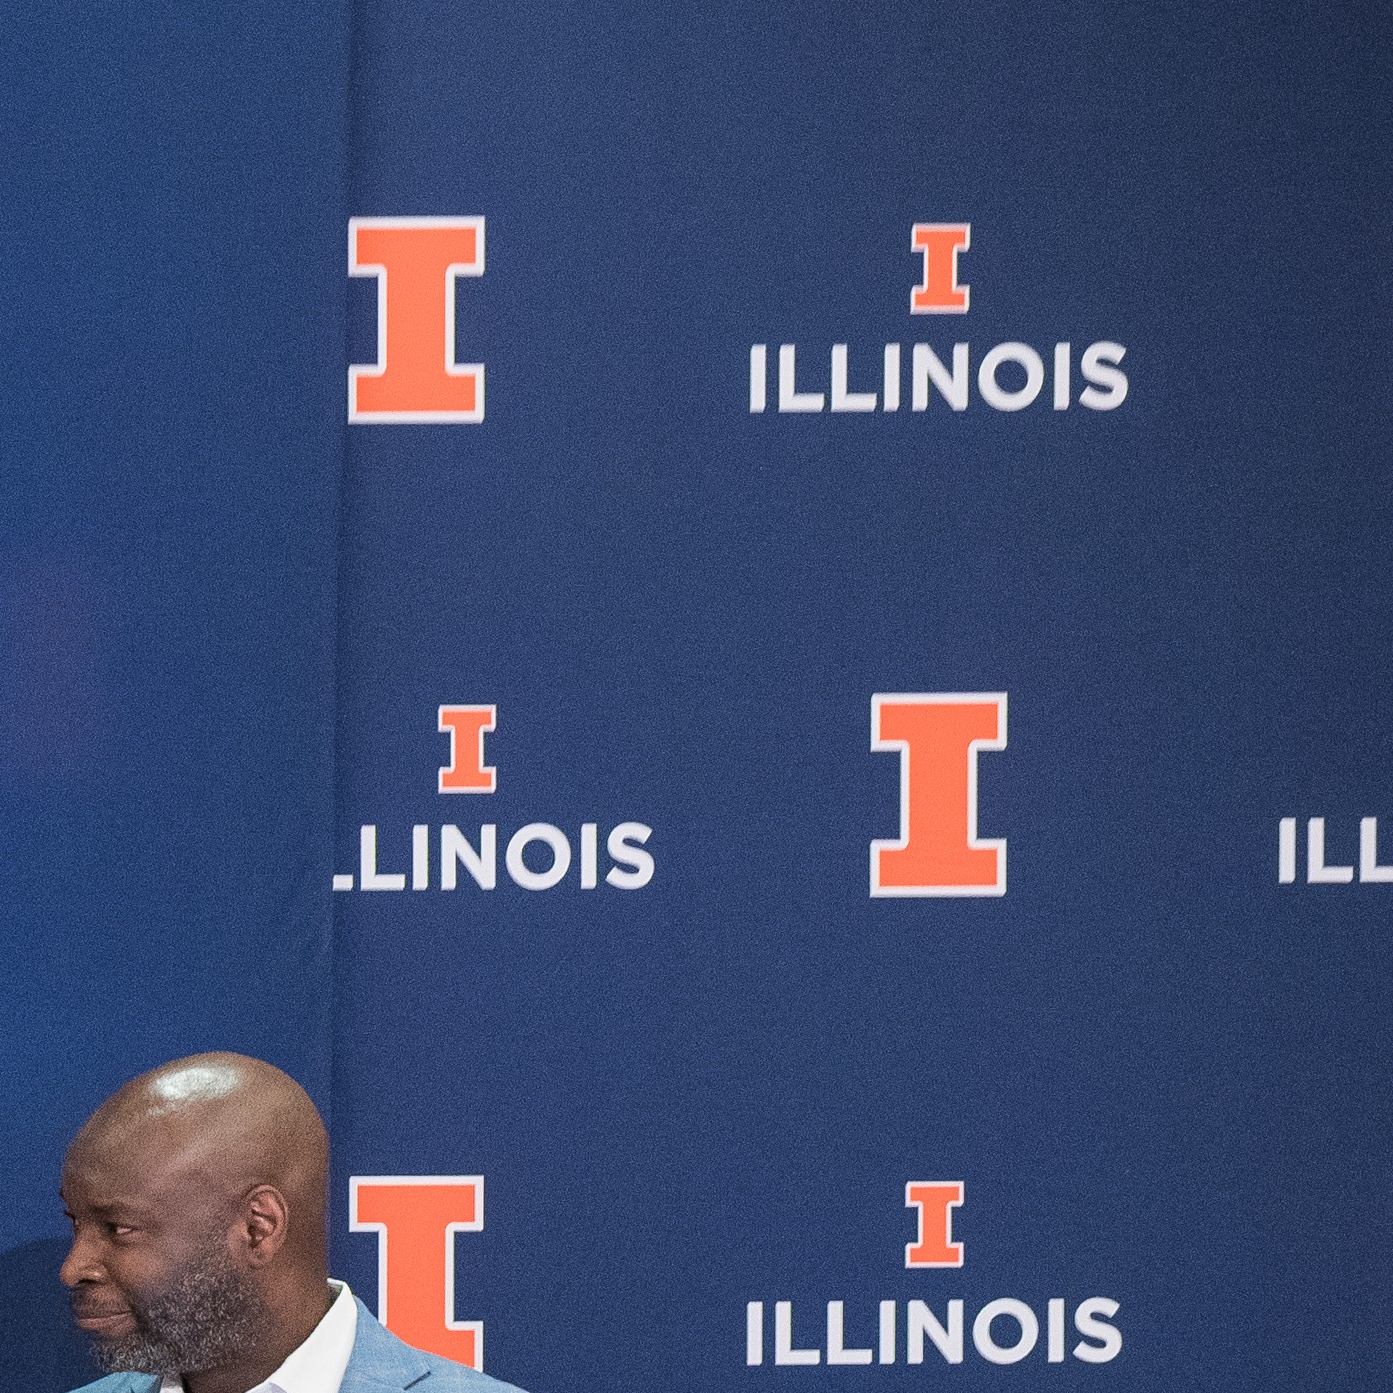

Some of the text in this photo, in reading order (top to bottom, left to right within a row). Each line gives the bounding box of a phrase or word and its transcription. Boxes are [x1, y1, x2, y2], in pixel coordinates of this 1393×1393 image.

[910, 222, 972, 315] I
[347, 215, 486, 425] I
[749, 340, 1129, 414] ILLINOIS
[437, 703, 497, 794] I
[869, 691, 1009, 898] I
[332, 821, 655, 893] LINOIS
[903, 1179, 965, 1270] I
[745, 1297, 1123, 1368] ILLINOIS
